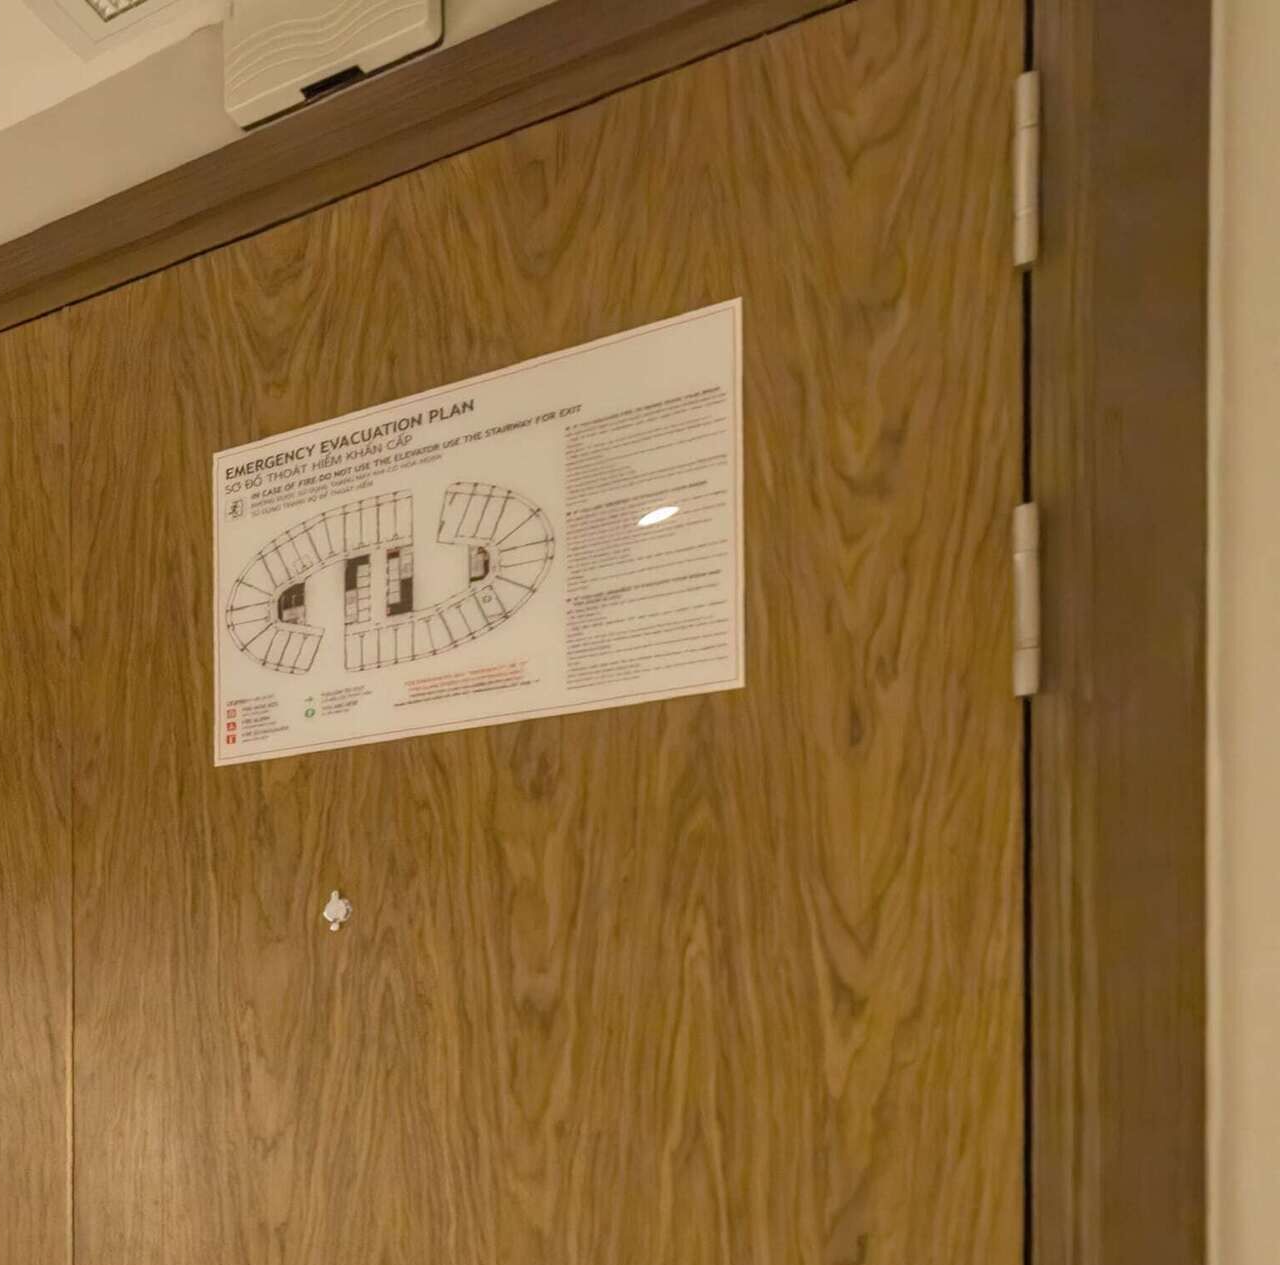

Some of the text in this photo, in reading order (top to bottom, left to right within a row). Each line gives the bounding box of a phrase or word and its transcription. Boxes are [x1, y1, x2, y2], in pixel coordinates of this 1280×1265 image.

[225, 399, 475, 480] EMERGENCY EVACUATION PLAN
[262, 485, 282, 498] CASE
[284, 481, 295, 491] OF
[298, 476, 316, 487] FIRE
[319, 472, 332, 482] DO
[334, 467, 352, 478] NOT
[354, 462, 370, 473] USE
[373, 456, 391, 469] THE
[393, 443, 440, 462] ELEVATOR
[442, 437, 460, 449] USE
[464, 431, 482, 443] THE
[485, 417, 532, 437] STAIRWAY
[535, 411, 556, 425] FOR
[559, 404, 582, 418] EXIT
